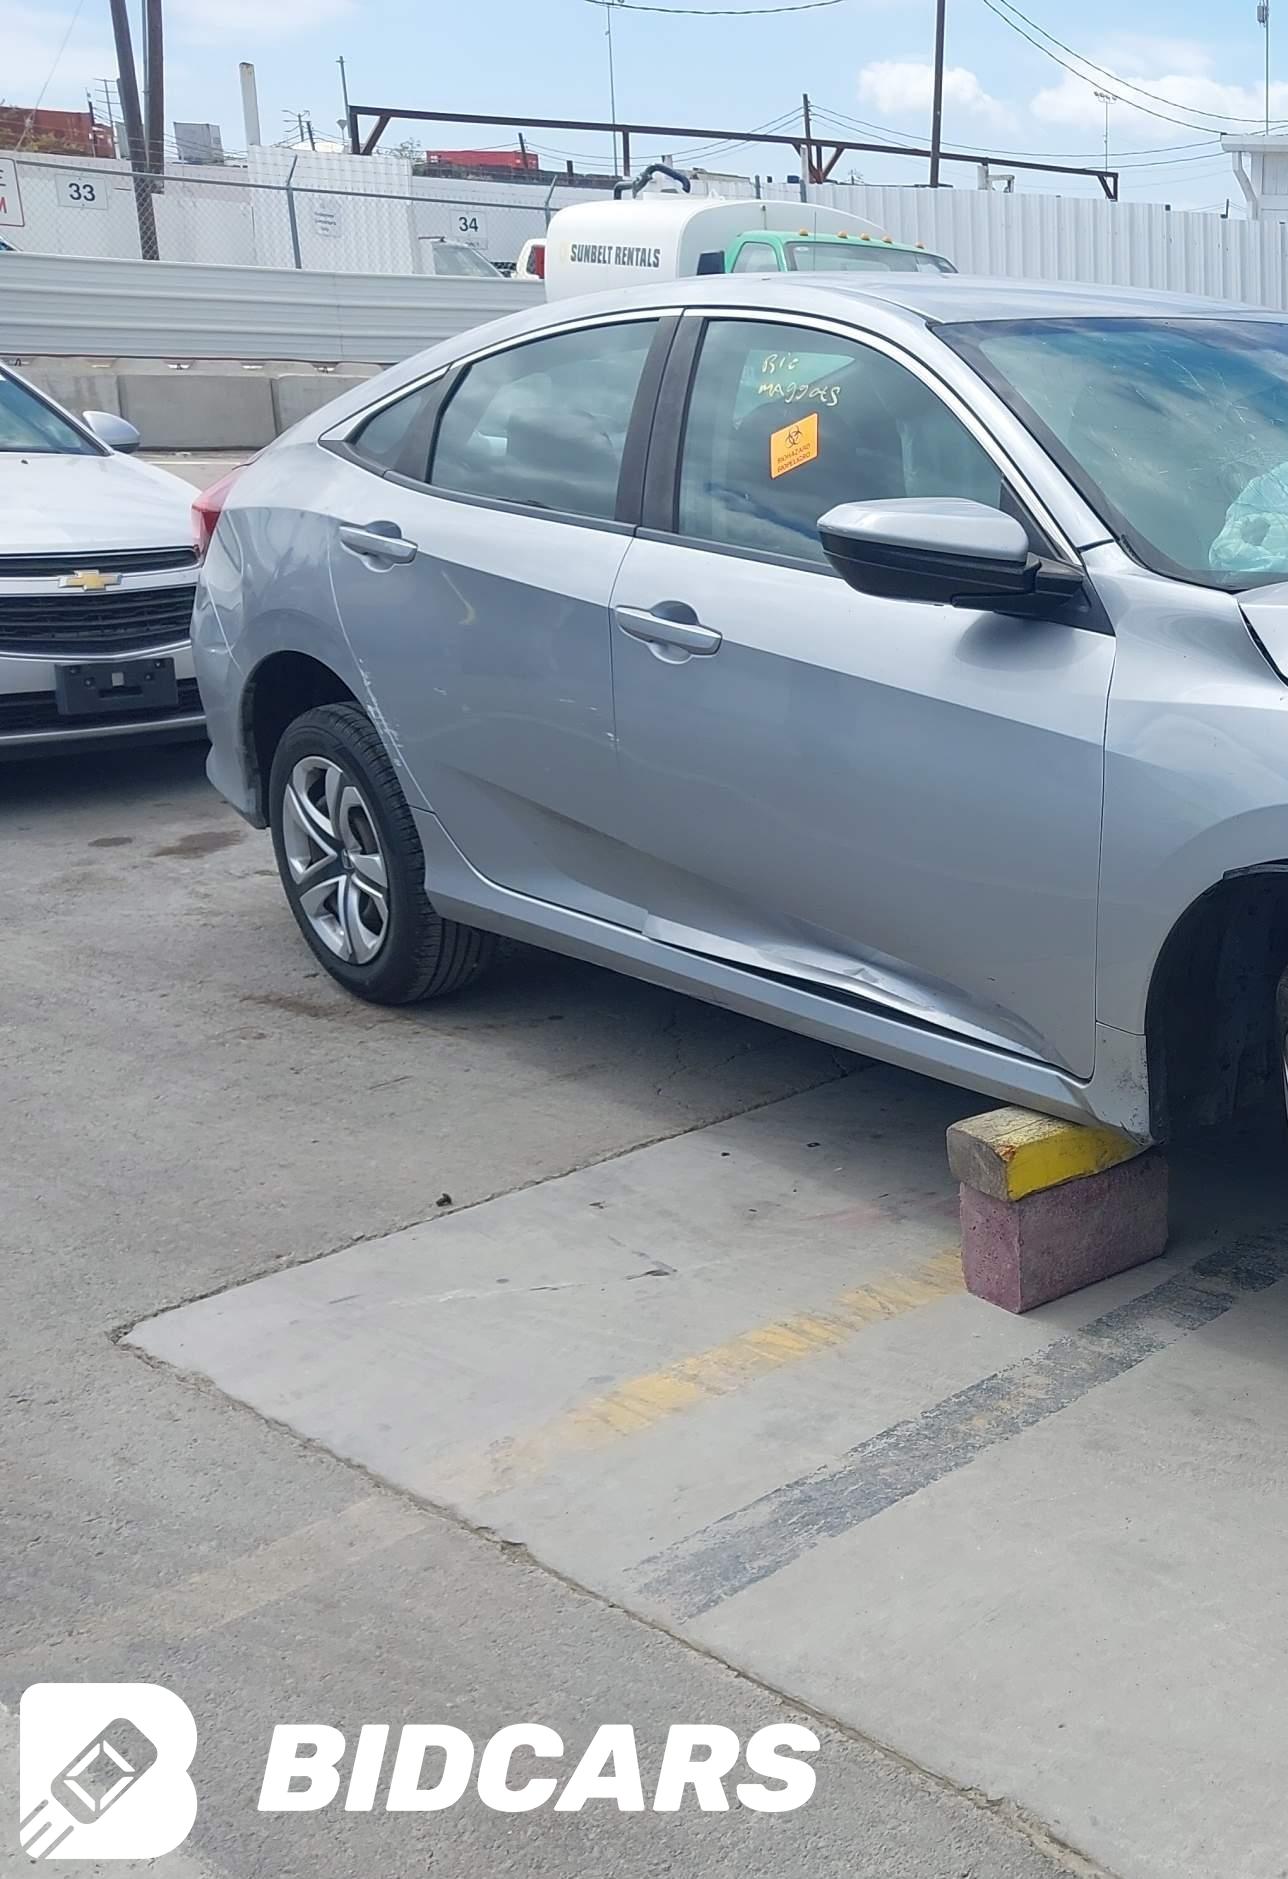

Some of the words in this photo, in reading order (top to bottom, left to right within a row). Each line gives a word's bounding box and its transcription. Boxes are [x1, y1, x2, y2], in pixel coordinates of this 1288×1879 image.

[68, 182, 96, 202] 33
[458, 216, 479, 233] 34
[570, 243, 613, 264] SUNBELT
[614, 246, 661, 268] RENTALS
